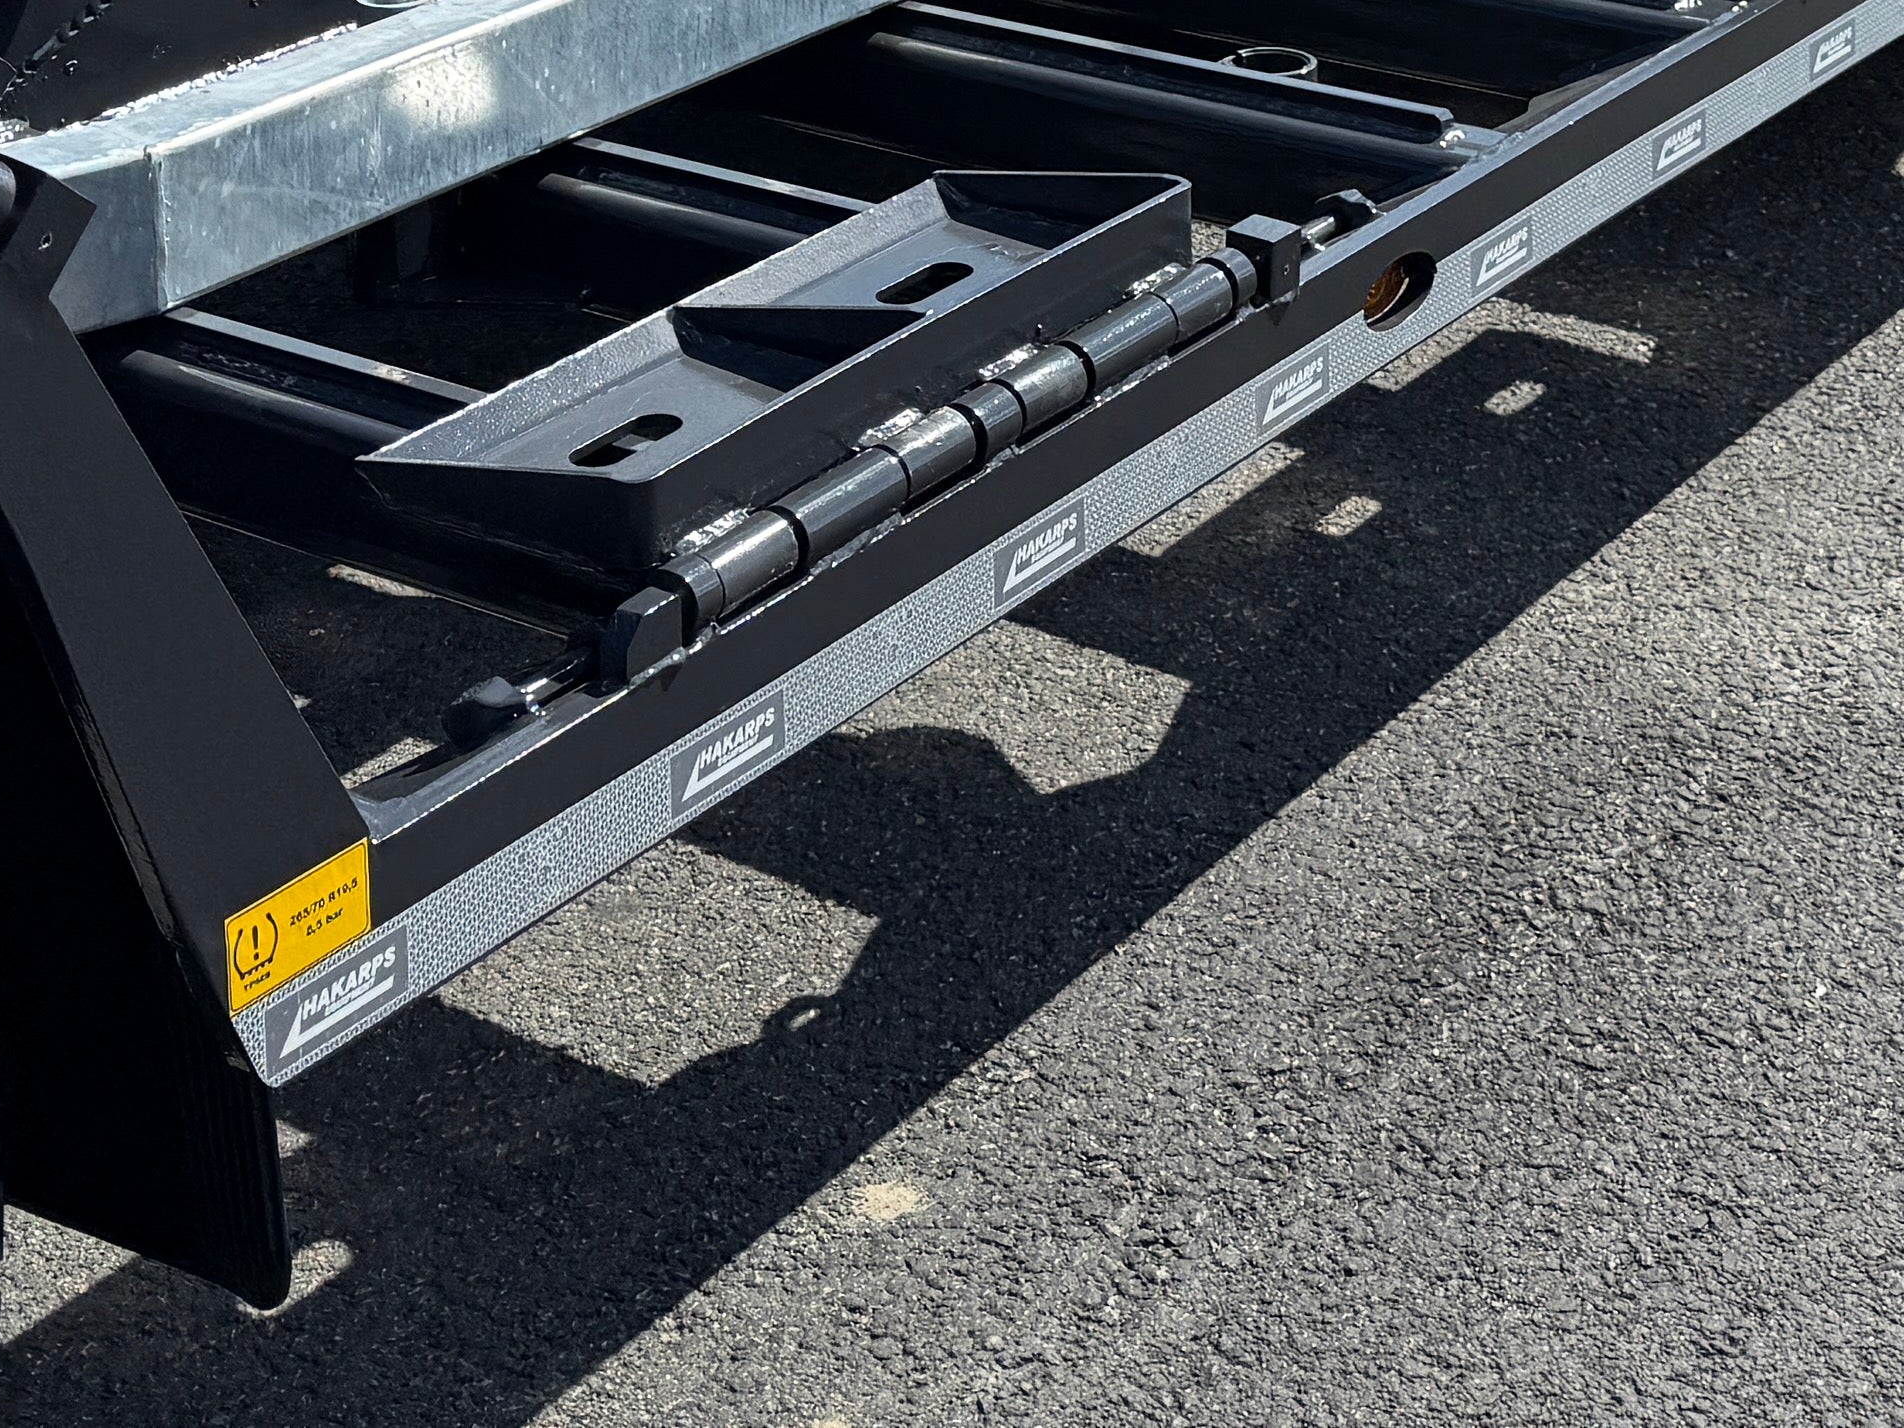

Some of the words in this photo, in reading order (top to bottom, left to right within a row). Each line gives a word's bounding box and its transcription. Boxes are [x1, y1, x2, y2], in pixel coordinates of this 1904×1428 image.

[1017, 512, 1078, 565] HAKARPS
[700, 707, 775, 769] HAKARPS
[302, 945, 396, 1020] HAKARPS
